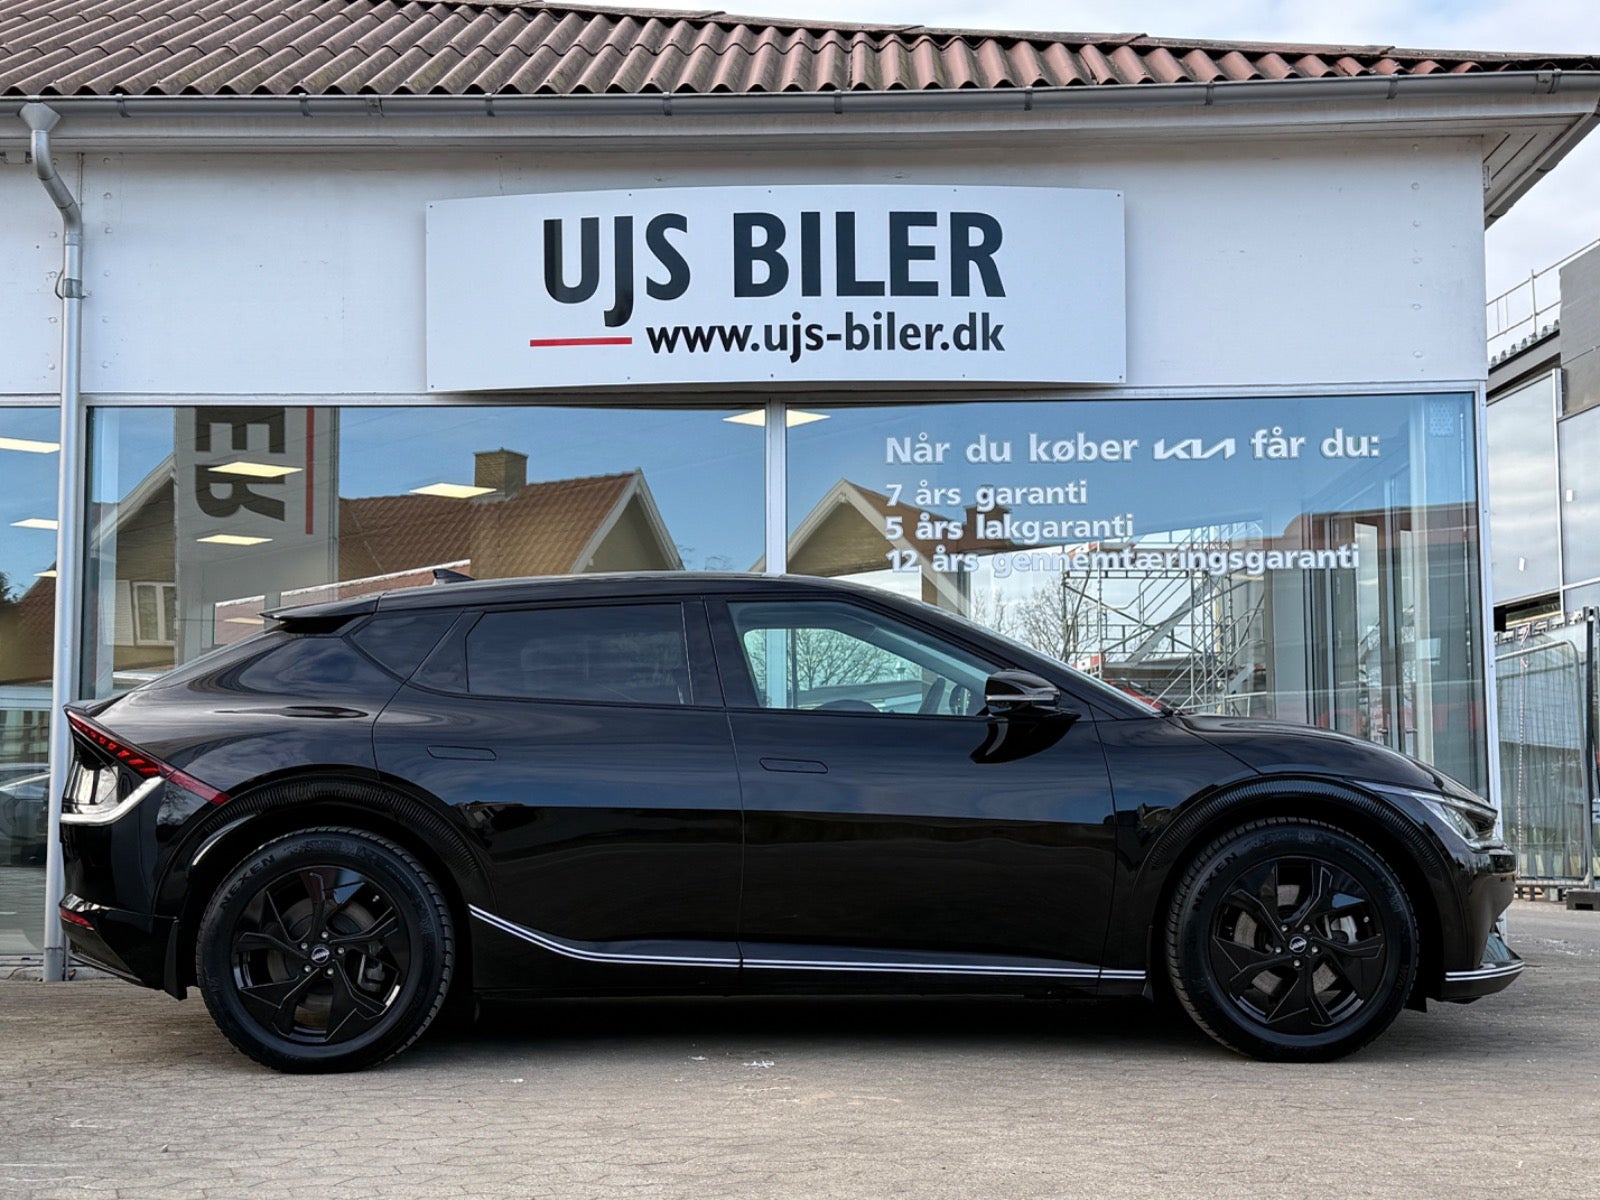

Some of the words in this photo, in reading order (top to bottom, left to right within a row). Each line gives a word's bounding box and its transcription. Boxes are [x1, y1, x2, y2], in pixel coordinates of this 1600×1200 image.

[543, 213, 691, 328] UJS
[732, 211, 1007, 298] BILER
[646, 310, 1006, 364] www.ujs-biler.dk
[885, 433, 951, 465] Når
[966, 434, 1012, 464] du
[1029, 431, 1140, 463] køber
[1250, 426, 1306, 459] får
[1320, 427, 1381, 459] du:
[885, 483, 903, 506] 7
[915, 480, 961, 506] års
[975, 478, 1088, 512] garanti
[885, 516, 904, 541] 5
[914, 512, 963, 540] års
[975, 513, 1135, 544] lakgaranti
[885, 550, 919, 573] 12
[932, 546, 978, 572] års
[993, 543, 1360, 577] gennemtæringsgaranti
[220, 854, 276, 910] NEXEN
[1192, 851, 1239, 912] NEXEN
